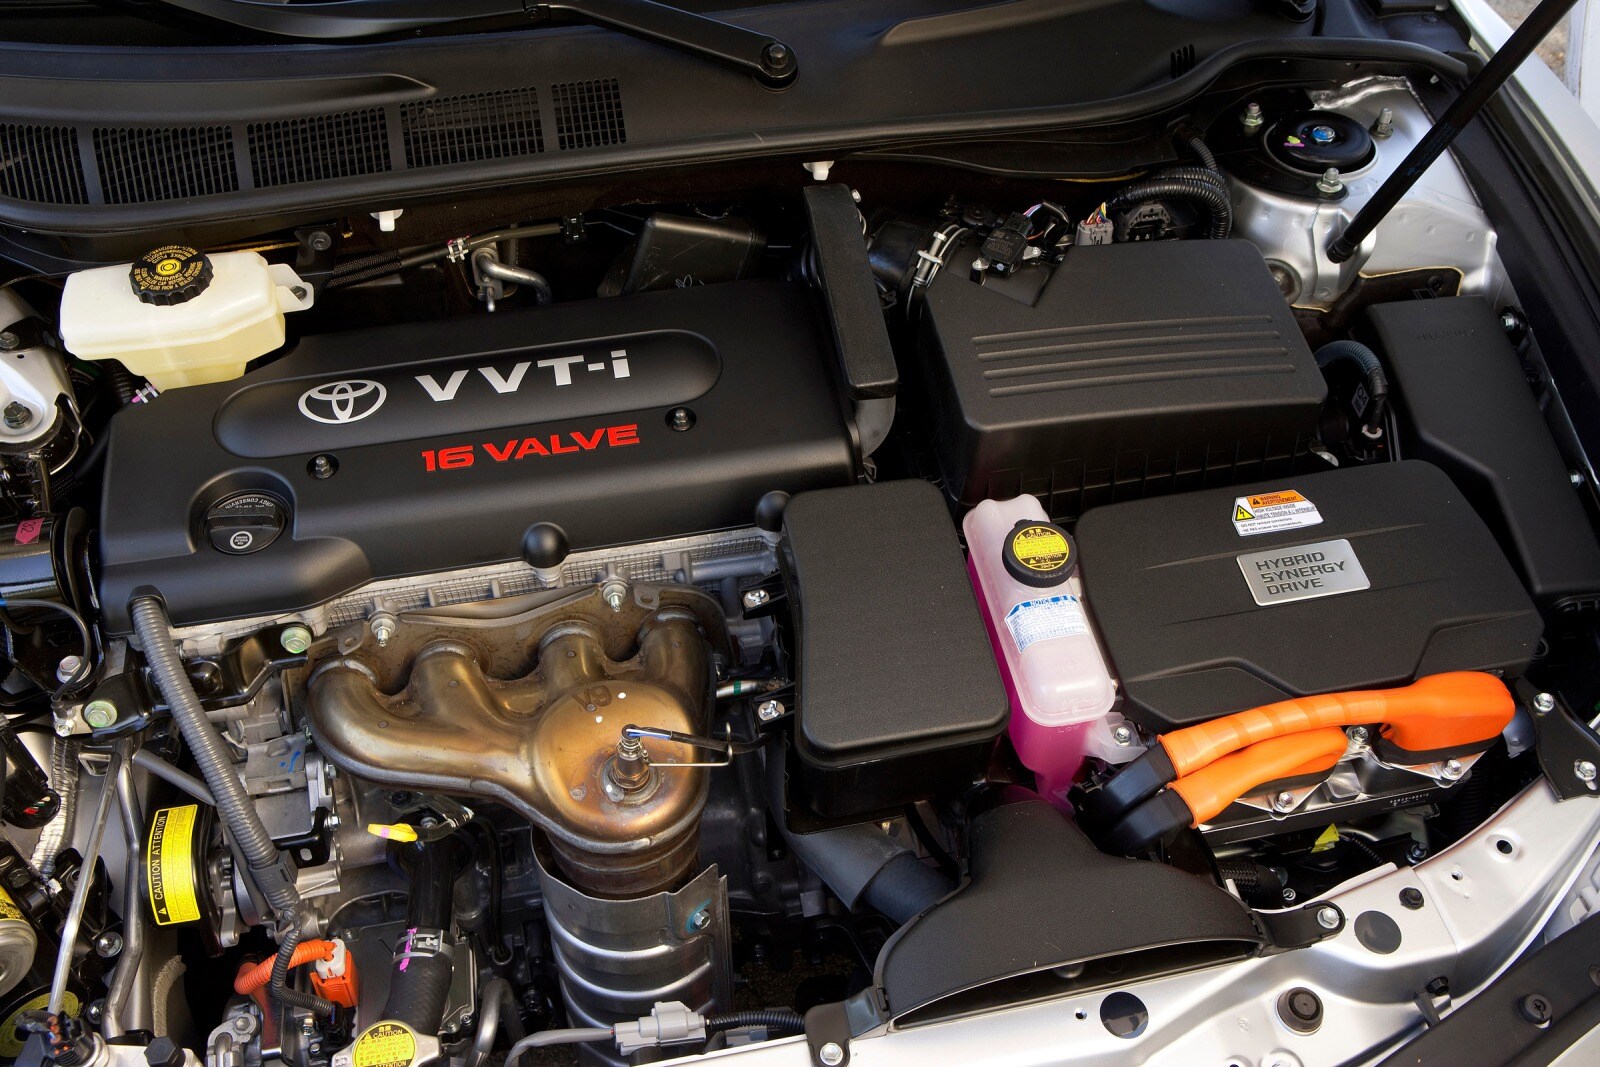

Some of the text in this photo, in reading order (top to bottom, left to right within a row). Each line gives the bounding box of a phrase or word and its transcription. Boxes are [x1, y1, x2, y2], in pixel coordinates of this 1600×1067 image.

[154, 273, 182, 281] WARNING
[414, 349, 631, 402] VVT-i
[421, 424, 640, 472] 16 VALVE
[21, 521, 36, 534] 32
[1255, 552, 1325, 571] HYBRID
[1260, 561, 1345, 583] SYNERGY
[1266, 578, 1324, 595] DRIVE
[152, 816, 166, 900] CAUTION ATTENTION
[373, 1029, 403, 1038] CAUTION
